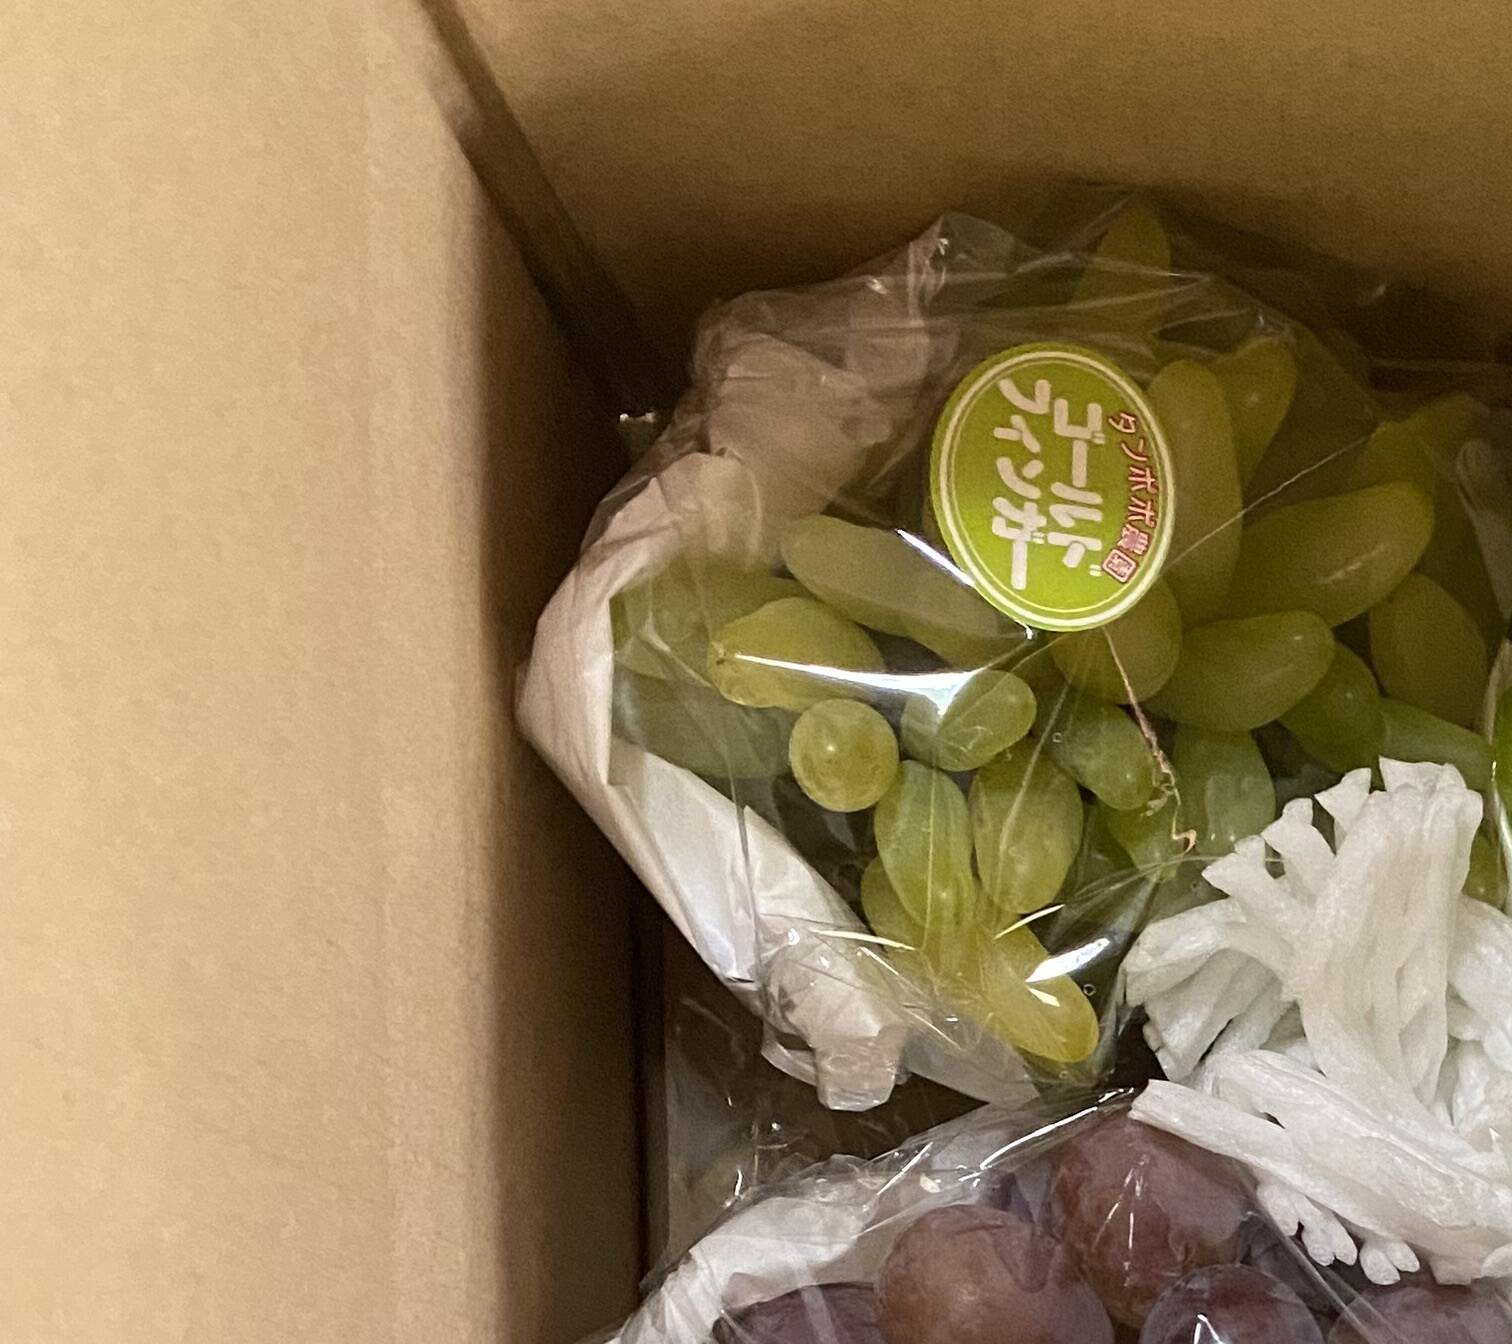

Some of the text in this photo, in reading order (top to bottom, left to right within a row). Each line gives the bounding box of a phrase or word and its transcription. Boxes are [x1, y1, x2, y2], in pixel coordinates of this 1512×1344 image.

[991, 377, 1050, 590] フィンガー
[1047, 398, 1105, 576] ゴールド
[1101, 410, 1158, 584] タンポポ農園
